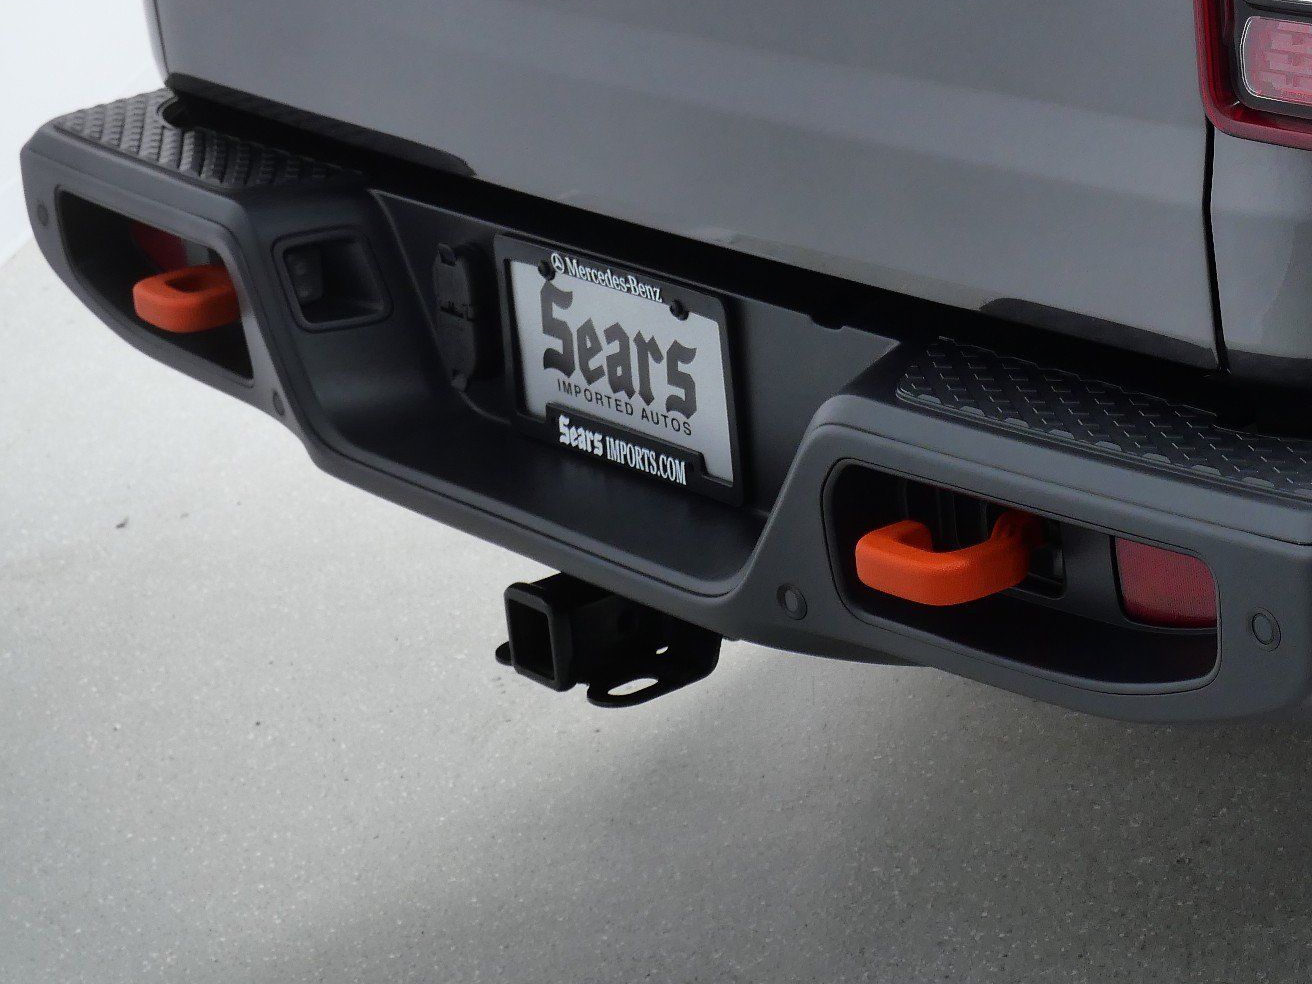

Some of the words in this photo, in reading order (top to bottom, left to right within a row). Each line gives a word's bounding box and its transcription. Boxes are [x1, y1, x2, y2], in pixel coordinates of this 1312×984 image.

[565, 256, 663, 303] Mercedes-Benz
[539, 280, 698, 420] Sears
[556, 378, 635, 417] IMPORTED
[640, 407, 693, 436] AUTOS
[558, 414, 604, 457] Sears
[605, 436, 688, 486] IMPORTS.COM
